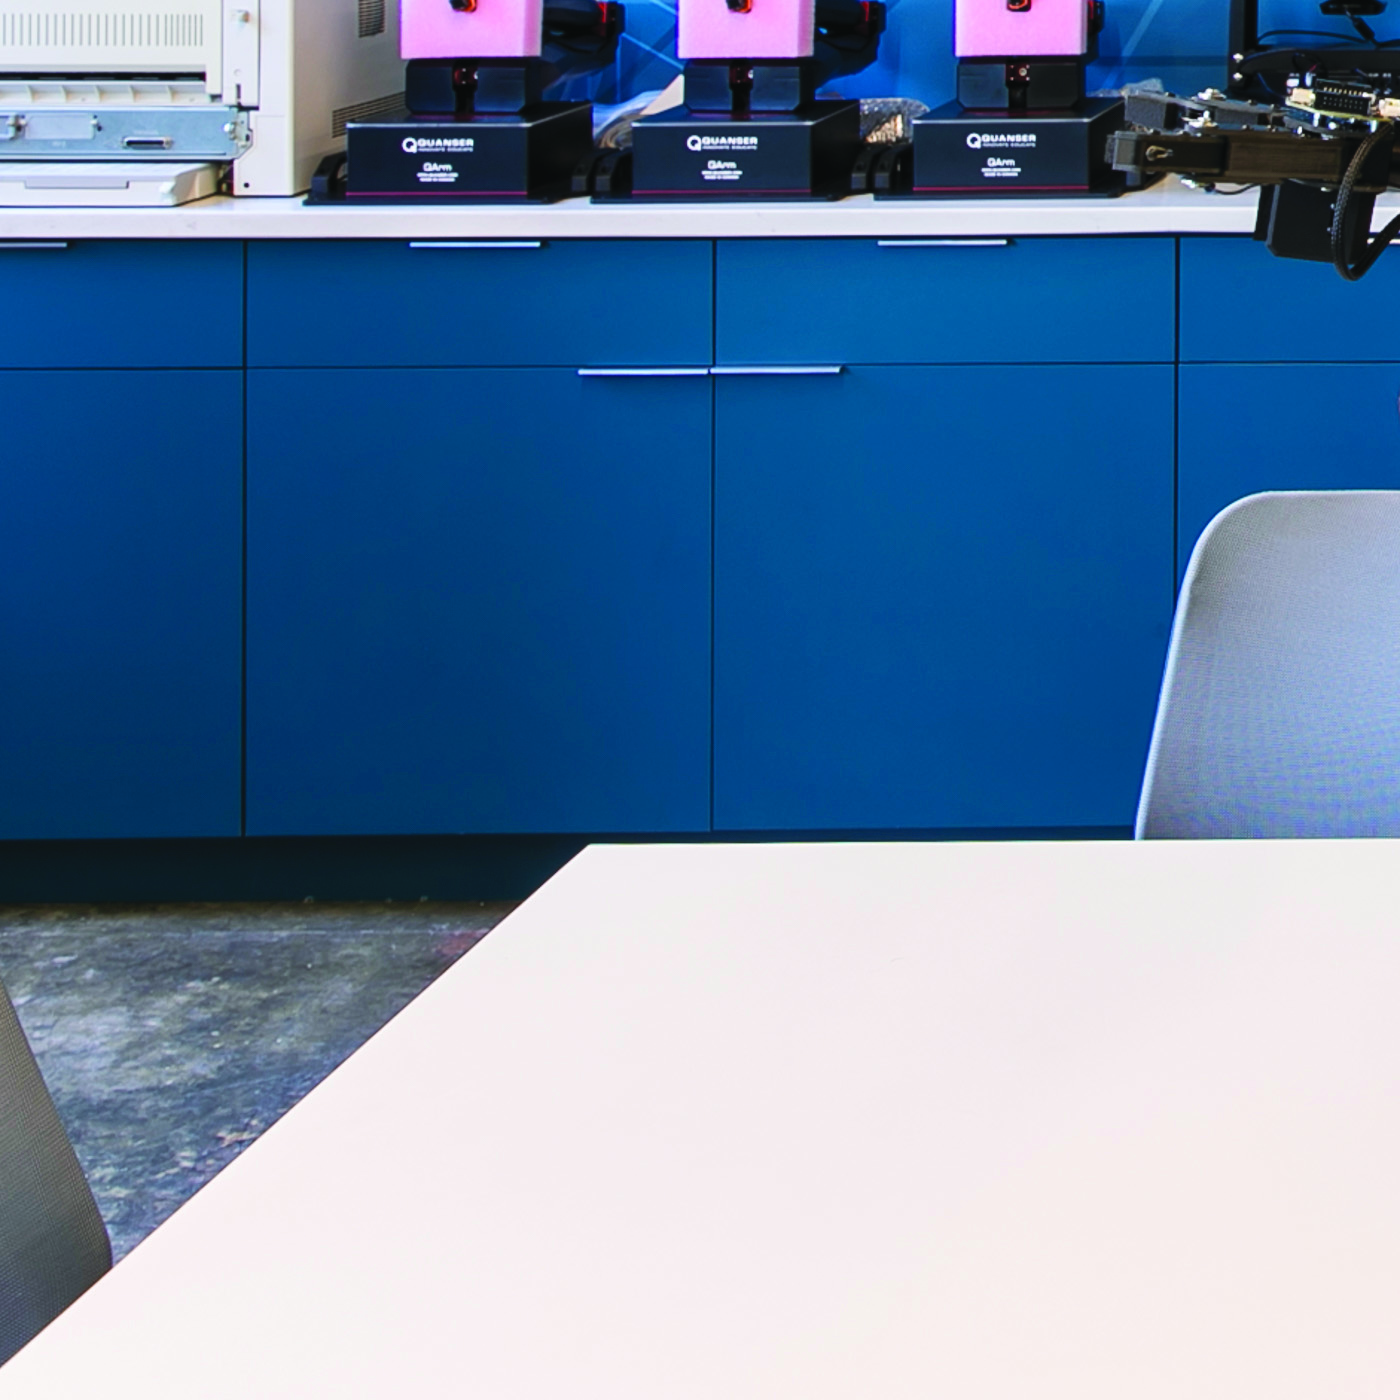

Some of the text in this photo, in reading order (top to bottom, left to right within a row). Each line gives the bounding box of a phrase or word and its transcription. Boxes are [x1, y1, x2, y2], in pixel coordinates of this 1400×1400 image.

[417, 138, 474, 147] QUANSER
[702, 136, 758, 145] QUANSER
[982, 133, 1037, 143] QUANSER
